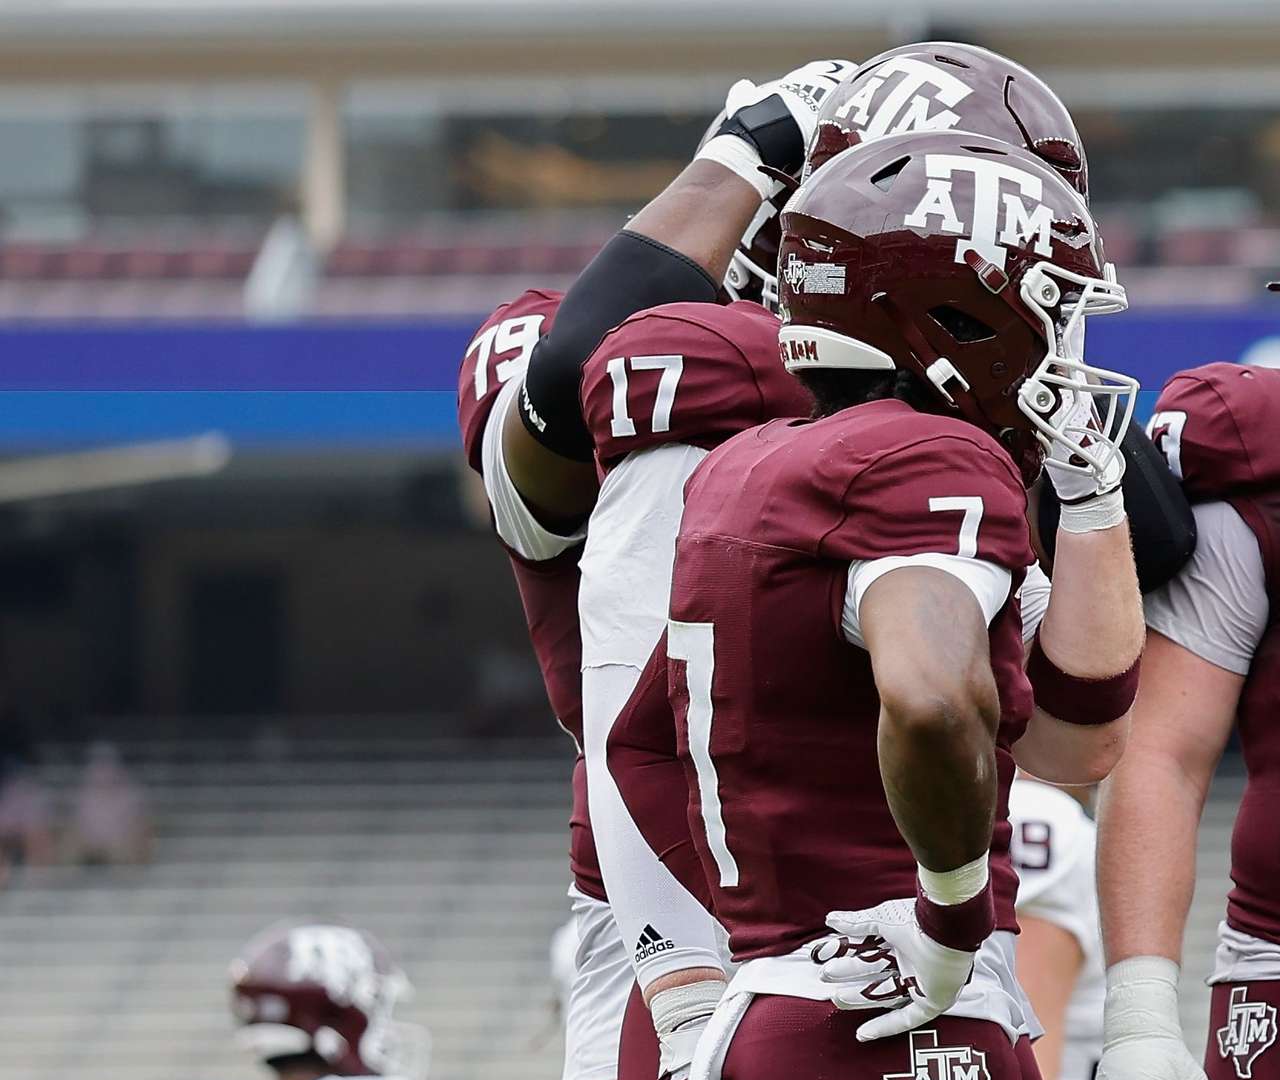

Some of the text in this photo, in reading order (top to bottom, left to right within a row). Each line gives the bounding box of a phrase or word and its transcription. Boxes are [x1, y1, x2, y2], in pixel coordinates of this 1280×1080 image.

[904, 154, 1054, 268] ATM
[466, 315, 546, 401] 79
[606, 355, 683, 438] 17
[929, 497, 985, 558] 7
[667, 618, 740, 888] 7
[635, 940, 674, 963] adidas
[1225, 1002, 1269, 1056] ATM
